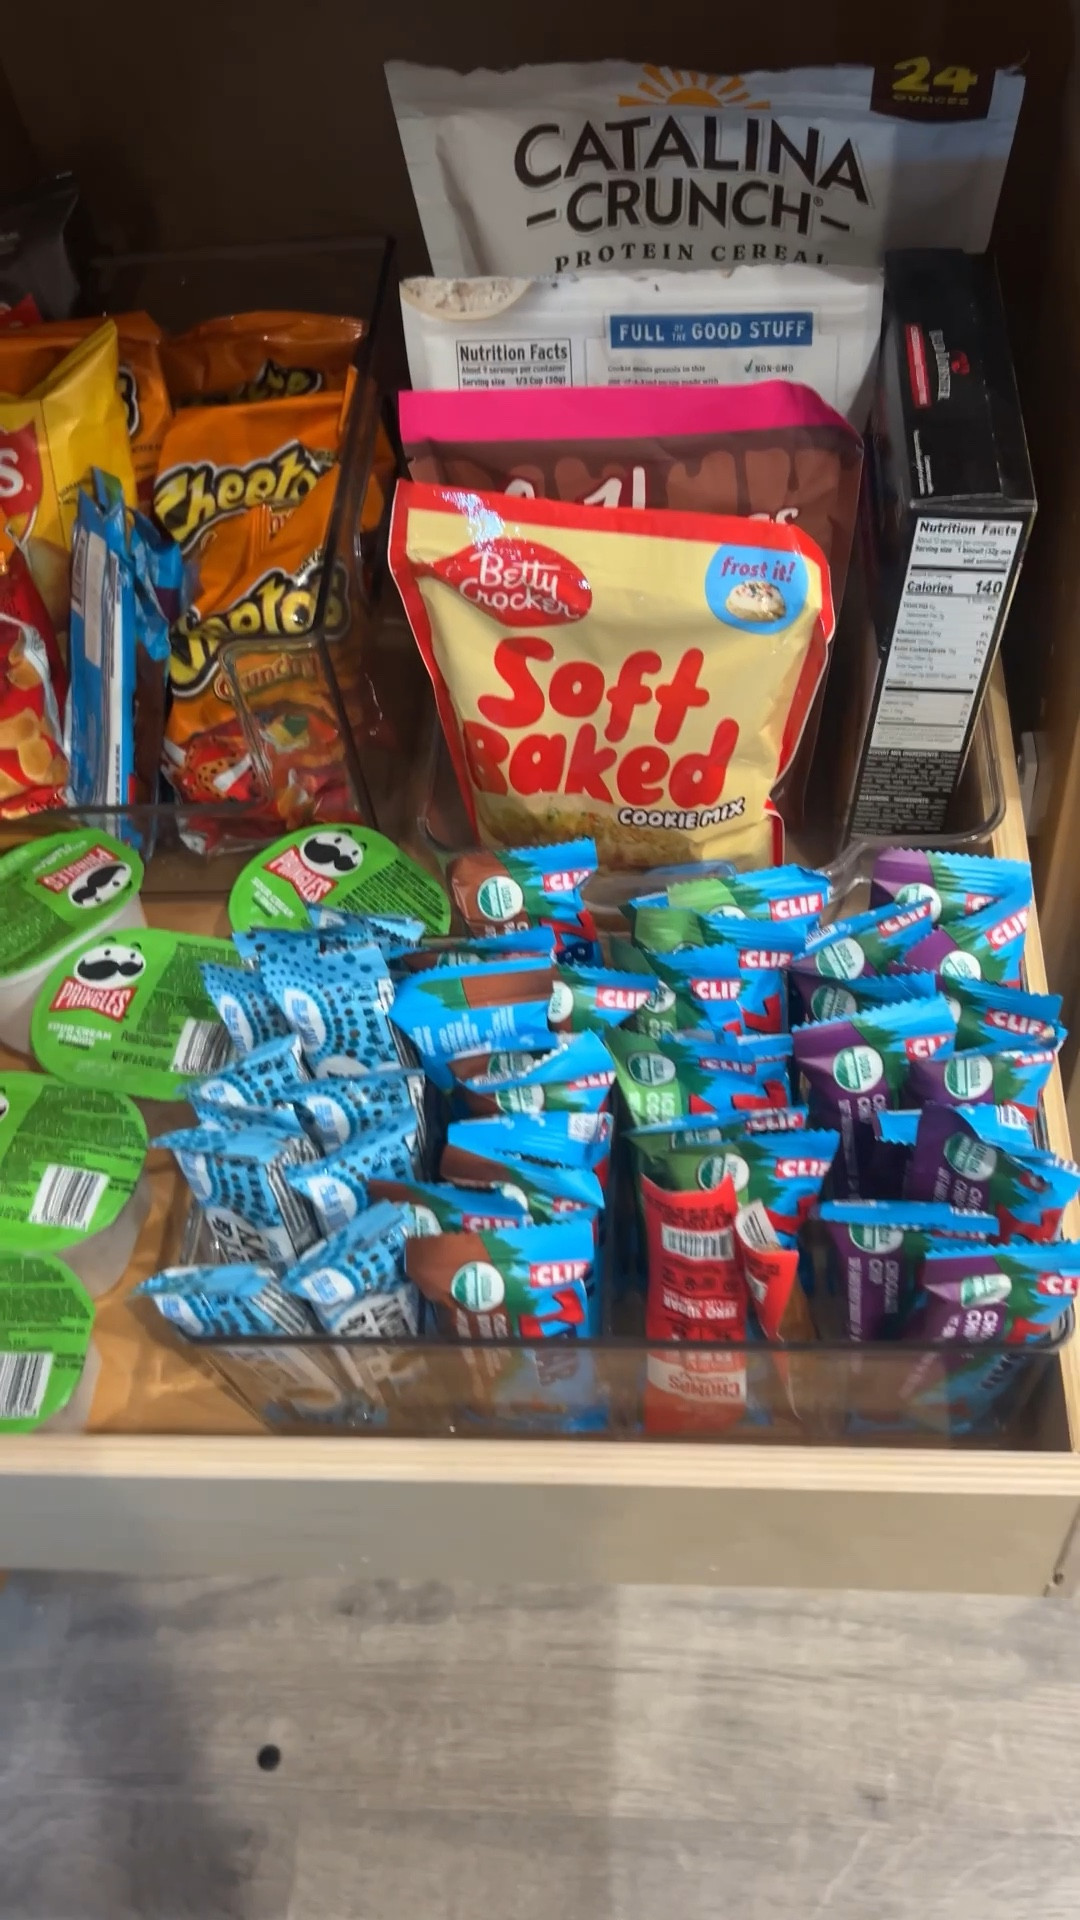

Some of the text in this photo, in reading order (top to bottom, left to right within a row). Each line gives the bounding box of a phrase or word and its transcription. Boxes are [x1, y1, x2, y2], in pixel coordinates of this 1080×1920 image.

[892, 57, 978, 93] 24
[514, 115, 868, 205] CATALINA
[555, 243, 694, 272] PROTEIN
[619, 324, 665, 341] FULL
[691, 322, 742, 340] GOOD
[749, 320, 806, 338] STUFF
[460, 343, 568, 361] Nutrition Facts
[755, 364, 794, 373] NON-GMO
[462, 378, 490, 388] Serving
[491, 378, 506, 386] size
[530, 376, 543, 387] Cup
[920, 522, 1018, 537] Nutrition Facts
[468, 551, 560, 592] Betty
[720, 556, 797, 584] frost it!
[459, 577, 578, 619] Crocker
[907, 580, 1003, 594] Calories 140
[477, 636, 710, 744] Soft
[618, 797, 746, 830] COOKIE MIX
[775, 894, 820, 918] CLIF
[881, 904, 932, 932] CLIF
[745, 952, 791, 967] CLIF
[56, 980, 132, 1019] PRINGLES
[698, 980, 741, 999] CLIF
[990, 1012, 1046, 1035] CLIF
